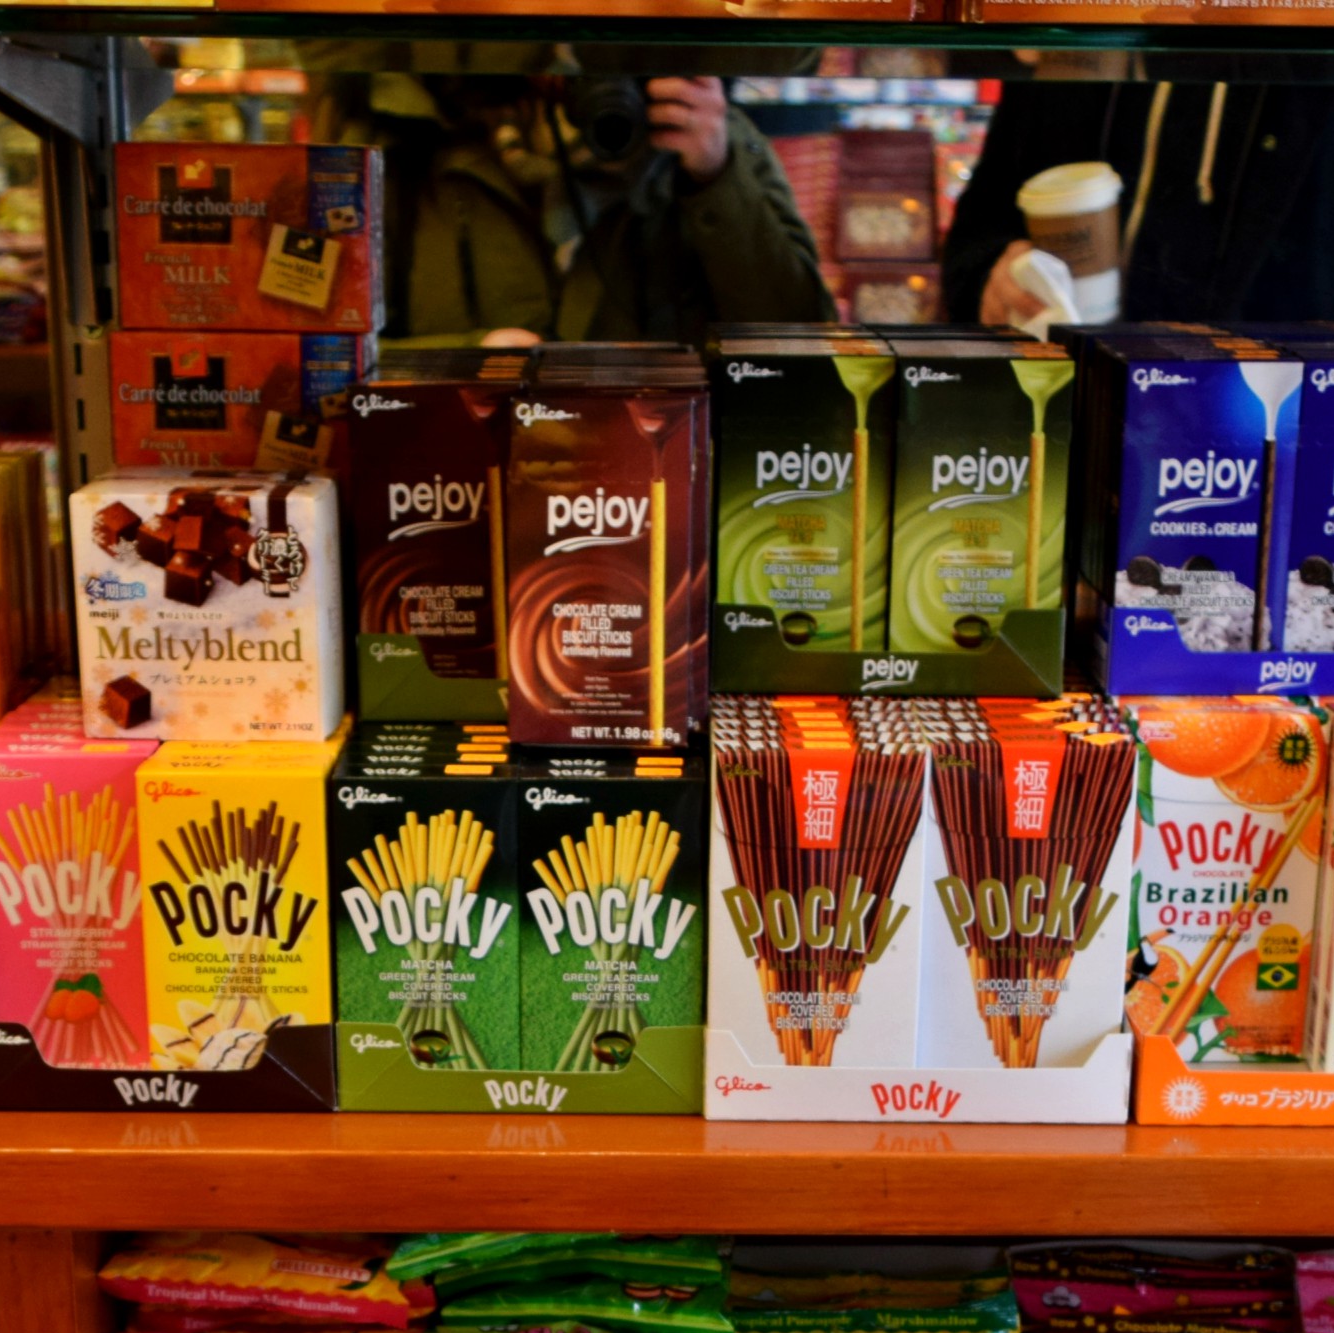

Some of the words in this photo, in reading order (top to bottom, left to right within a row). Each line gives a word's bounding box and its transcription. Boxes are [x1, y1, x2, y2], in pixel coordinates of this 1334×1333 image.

[173, 196, 192, 214] de
[195, 195, 266, 216] chocolat
[163, 266, 230, 284] MILK
[757, 444, 852, 489] pejoy
[932, 448, 1029, 493] pejoy
[1159, 451, 1258, 497] pejoy
[388, 475, 484, 520] pejoy
[89, 609, 120, 620] meiji
[553, 603, 606, 618] CHOCOLATE
[580, 618, 611, 631] FILLED
[562, 630, 598, 644] BISCUIT
[600, 630, 631, 644] STICKS
[95, 625, 303, 671] Meltyblend
[149, 674, 256, 686] プレミアムショコラ
[572, 726, 592, 740] NET
[614, 727, 640, 740] 1.98
[803, 769, 840, 842] 極細
[1146, 882, 1288, 906] Brazilian
[935, 864, 1119, 952] Pocky
[341, 877, 512, 960] Pocky
[526, 878, 697, 960] Pocky
[1158, 905, 1273, 932] Orange
[30, 928, 115, 938] STRAWBERRY
[249, 953, 302, 963] BANANA
[401, 960, 453, 970] MATCHA
[584, 961, 637, 971] MATCHA
[195, 966, 234, 975] BANANA
[237, 966, 276, 975] CREAM
[379, 973, 414, 981] GREEN
[417, 973, 437, 981] TEA
[213, 976, 262, 984] COVERED
[403, 982, 452, 991] COVERED
[388, 991, 427, 1001] BISCUIT
[430, 992, 467, 1001] STICKS
[114, 1074, 199, 1107] Pocky
[871, 1080, 961, 1118] Pocky
